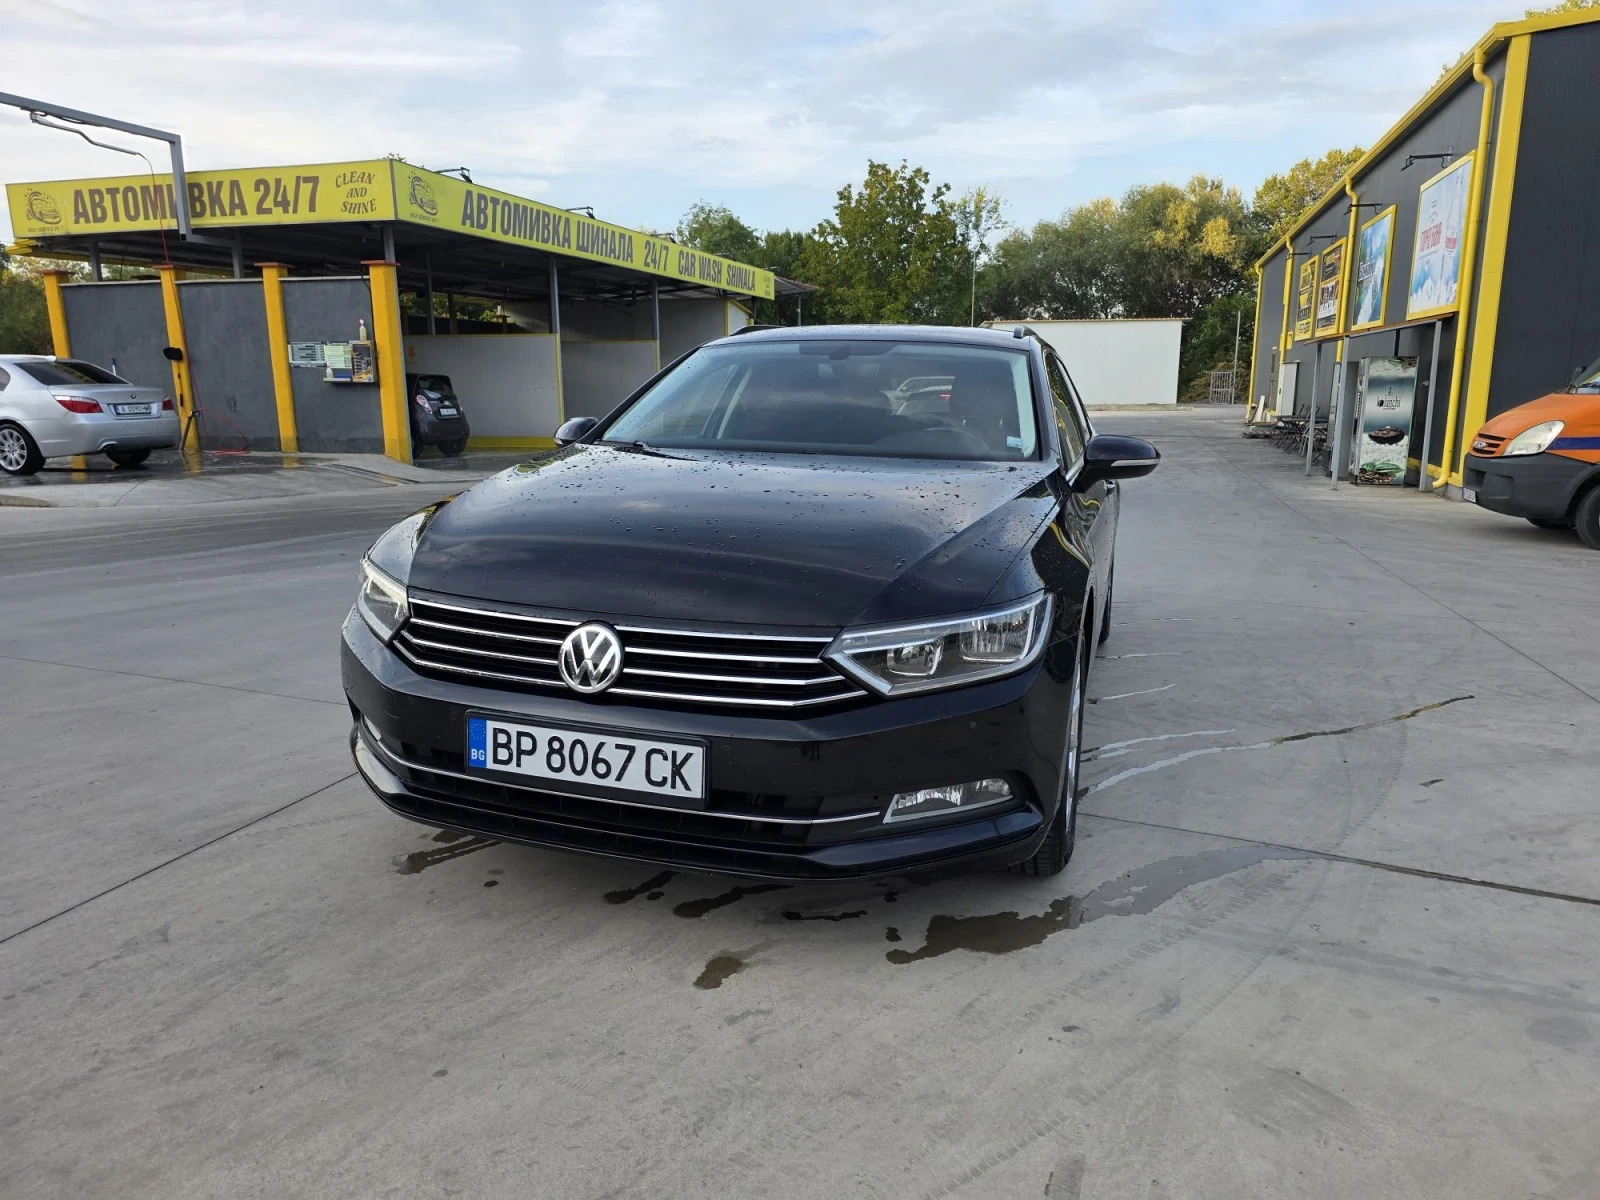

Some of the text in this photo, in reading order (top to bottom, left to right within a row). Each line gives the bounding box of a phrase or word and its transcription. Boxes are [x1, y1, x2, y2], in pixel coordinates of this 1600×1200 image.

[335, 170, 376, 189] CLEAN
[346, 187, 368, 199] AND
[254, 175, 320, 216] 24/7
[340, 198, 377, 215] SHINE
[461, 189, 572, 250] АВТОМИВКА
[575, 220, 634, 264] ШИНАЛА
[643, 239, 670, 272] 24/7
[678, 250, 697, 278] CAR
[698, 255, 723, 285] WASH
[726, 263, 756, 292] SHINALA
[471, 727, 694, 792] BG BP 8067 CK
